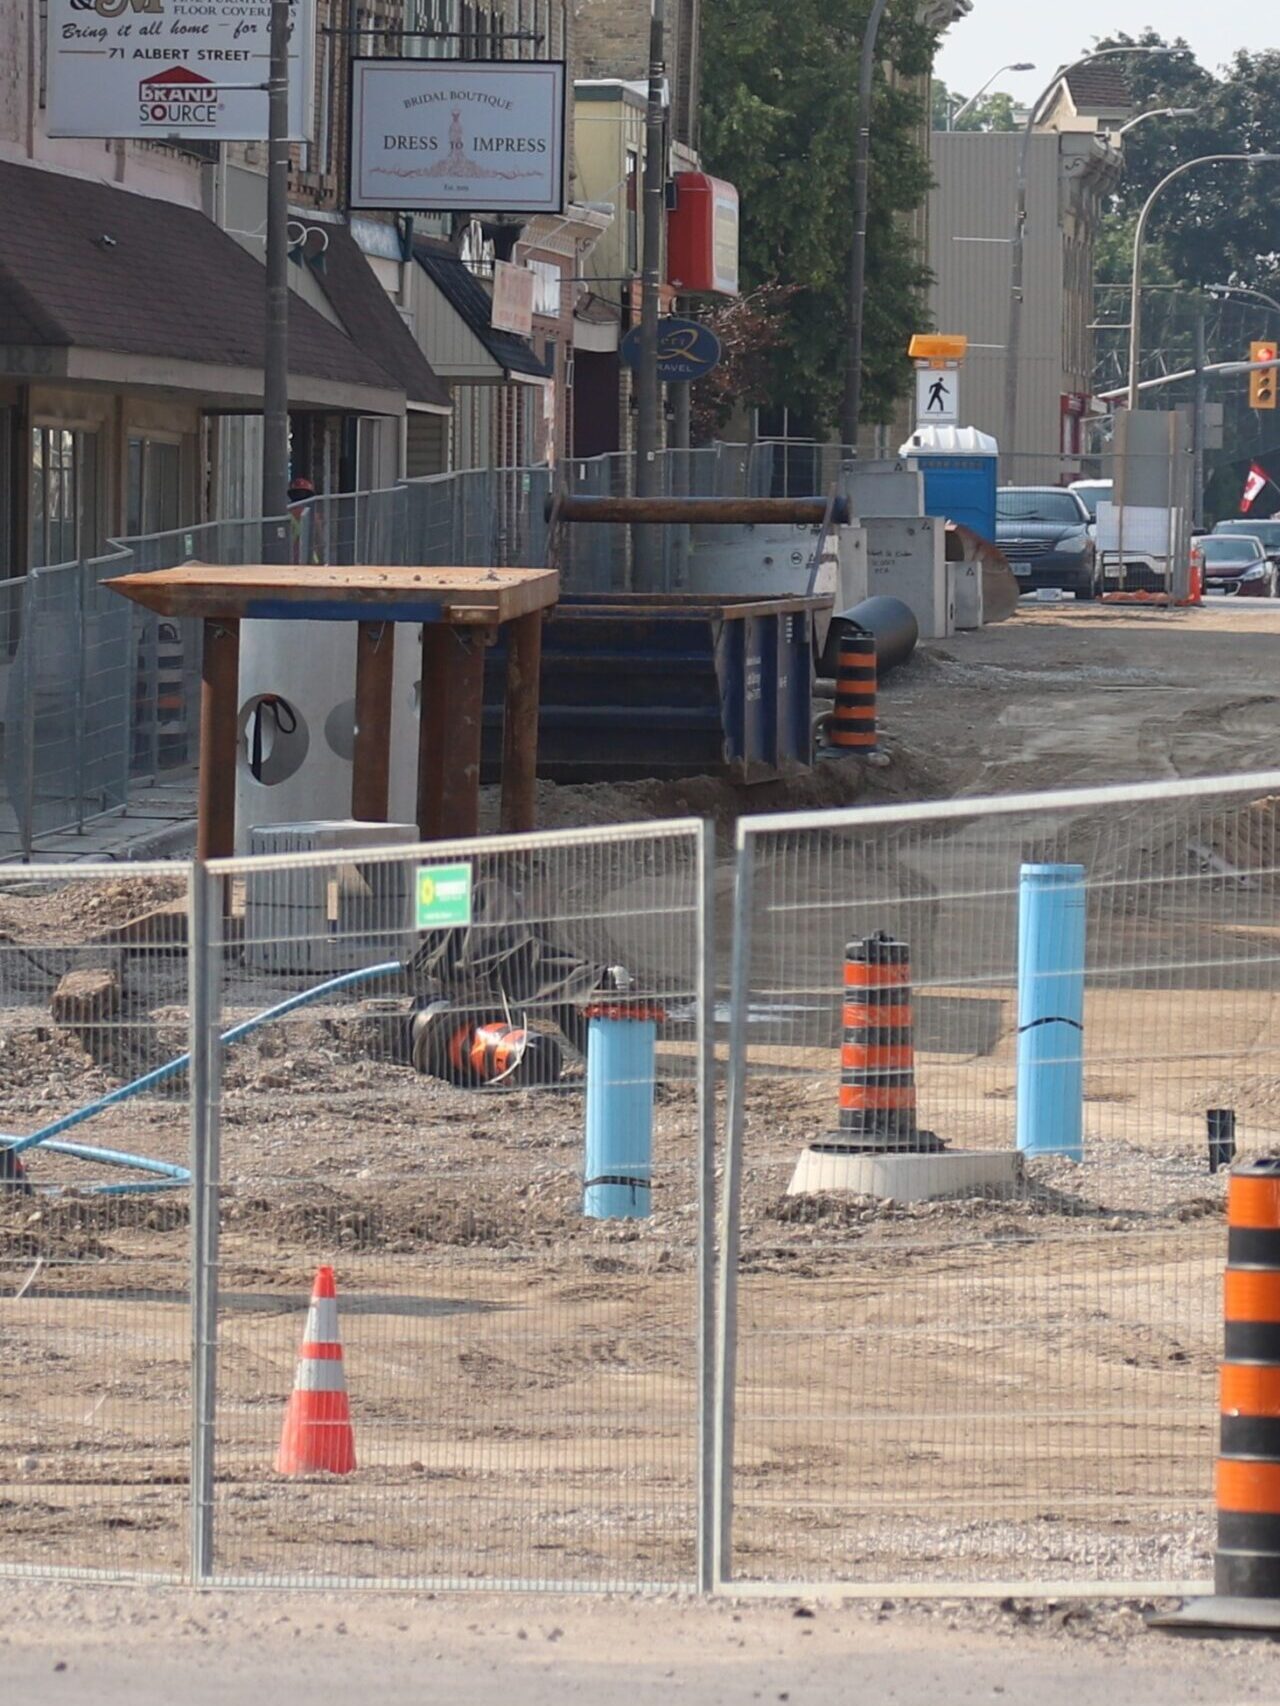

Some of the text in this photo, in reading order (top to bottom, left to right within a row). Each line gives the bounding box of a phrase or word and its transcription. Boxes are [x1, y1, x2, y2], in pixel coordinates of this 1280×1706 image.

[173, 5, 217, 16] FLOOR
[221, 6, 297, 17] COVERIS
[62, 23, 108, 42] Bring
[117, 23, 131, 37] it
[139, 21, 162, 36] all
[170, 19, 209, 35] home
[233, 20, 257, 40] for
[109, 48, 250, 61] 71 ALBERT STREET
[403, 90, 513, 111] BRIDAL BOUTIQUE
[139, 104, 217, 122] SOURCE
[384, 135, 438, 150] DRESS
[473, 137, 547, 153] IMPRESS
[656, 363, 694, 373] RAVEL
